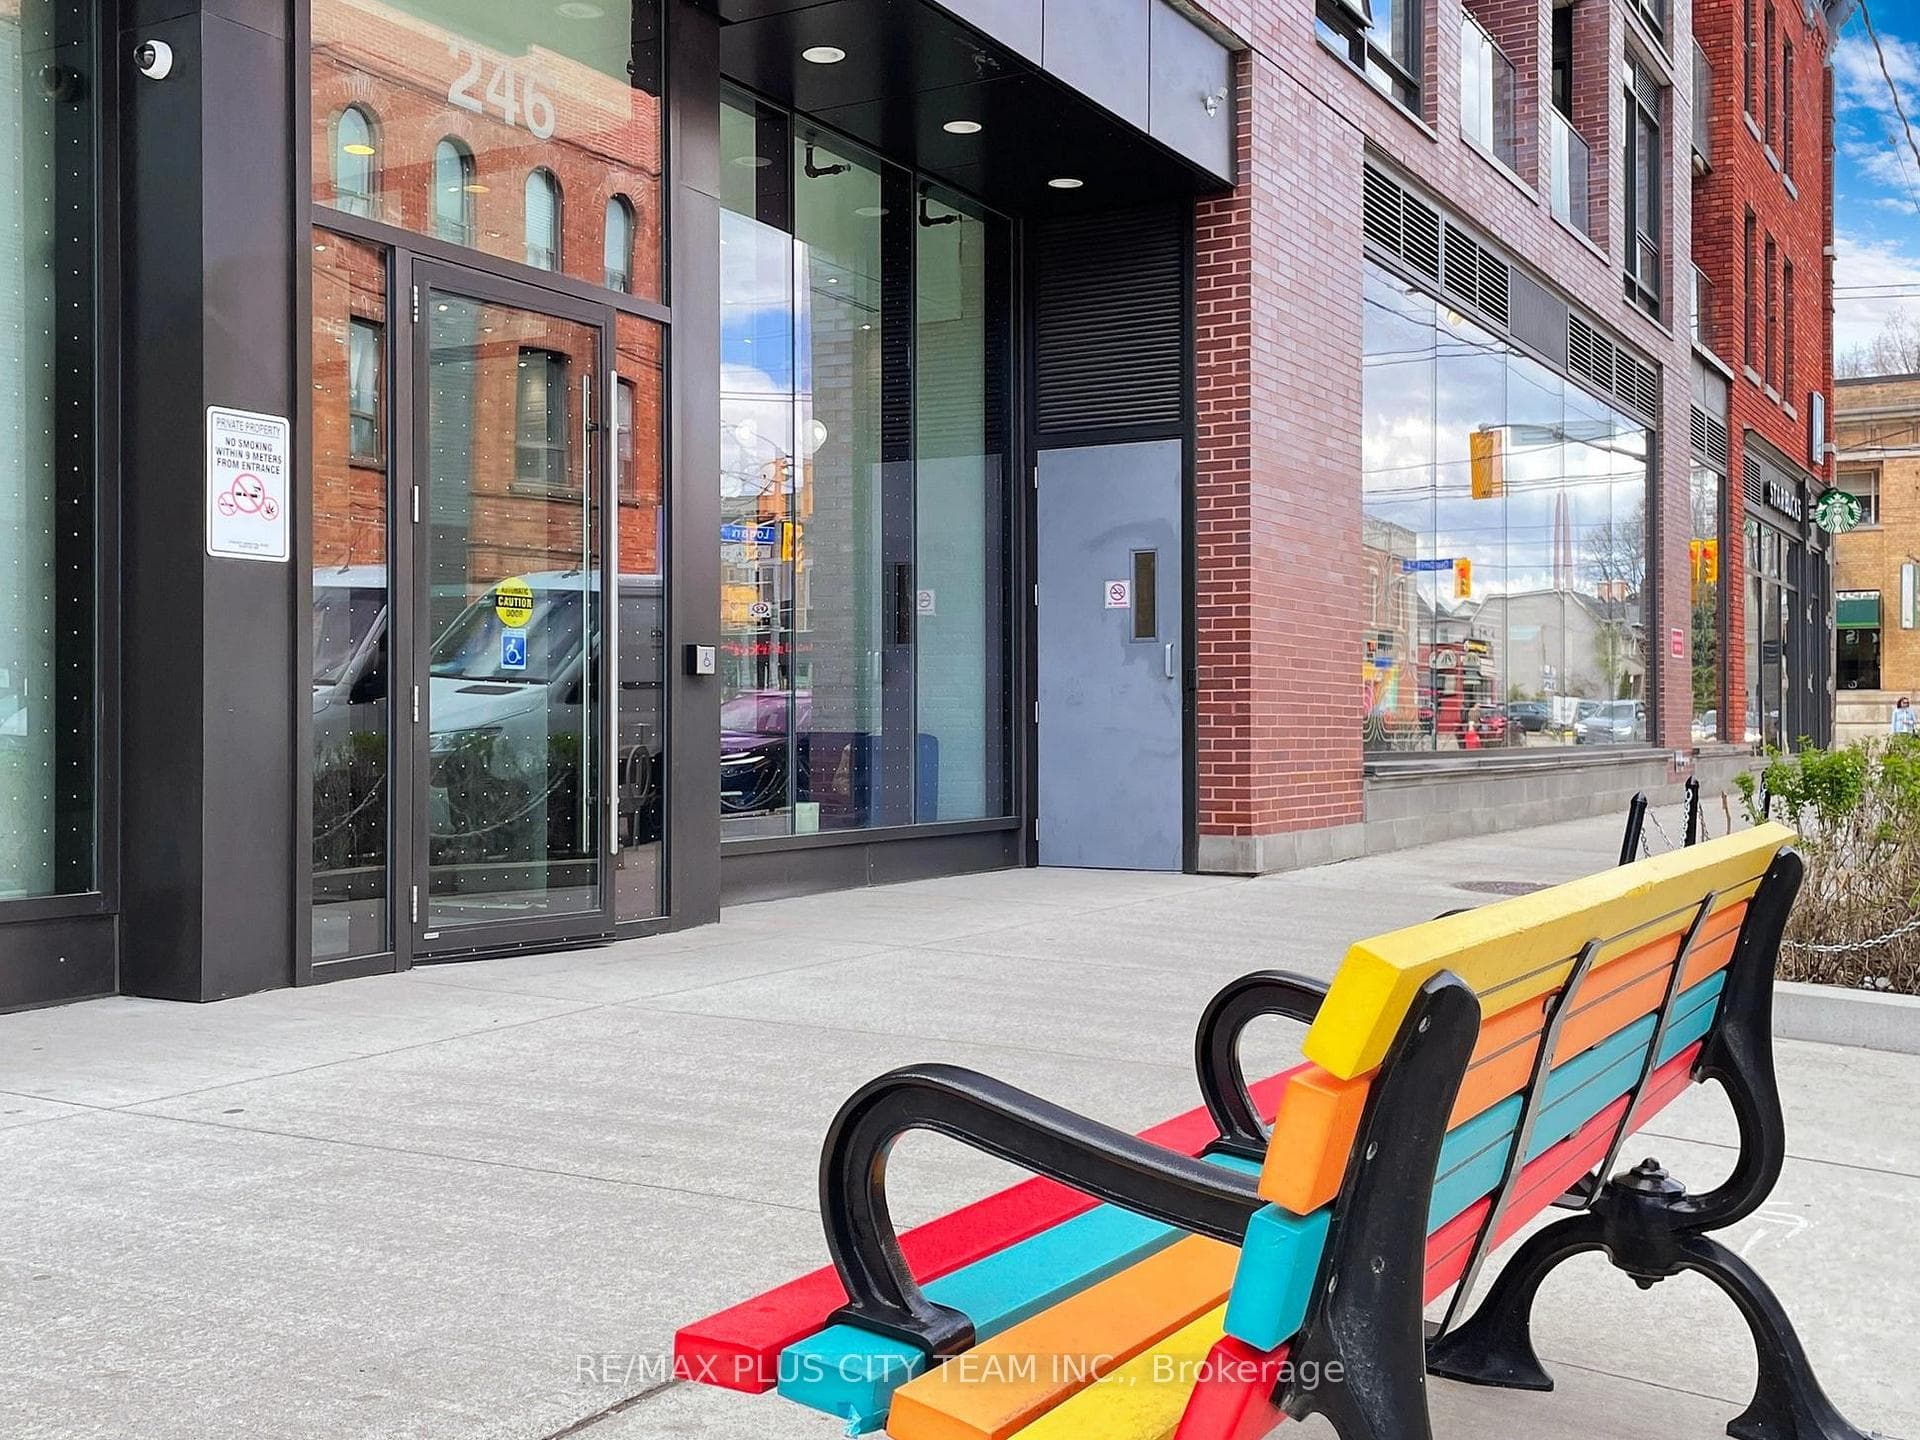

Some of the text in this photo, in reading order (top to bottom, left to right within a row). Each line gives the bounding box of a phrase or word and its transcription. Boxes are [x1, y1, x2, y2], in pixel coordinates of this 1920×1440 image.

[446, 40, 556, 140] 246
[216, 417, 281, 436] PRIVATE PROPERTY
[225, 436, 273, 452] NO SMOKING
[215, 446, 282, 464] WITHIN 9 METERS
[216, 458, 281, 475] FROM ENTRANCE
[1769, 480, 1802, 522] STARBUCKS
[498, 596, 532, 608] CAUTION
